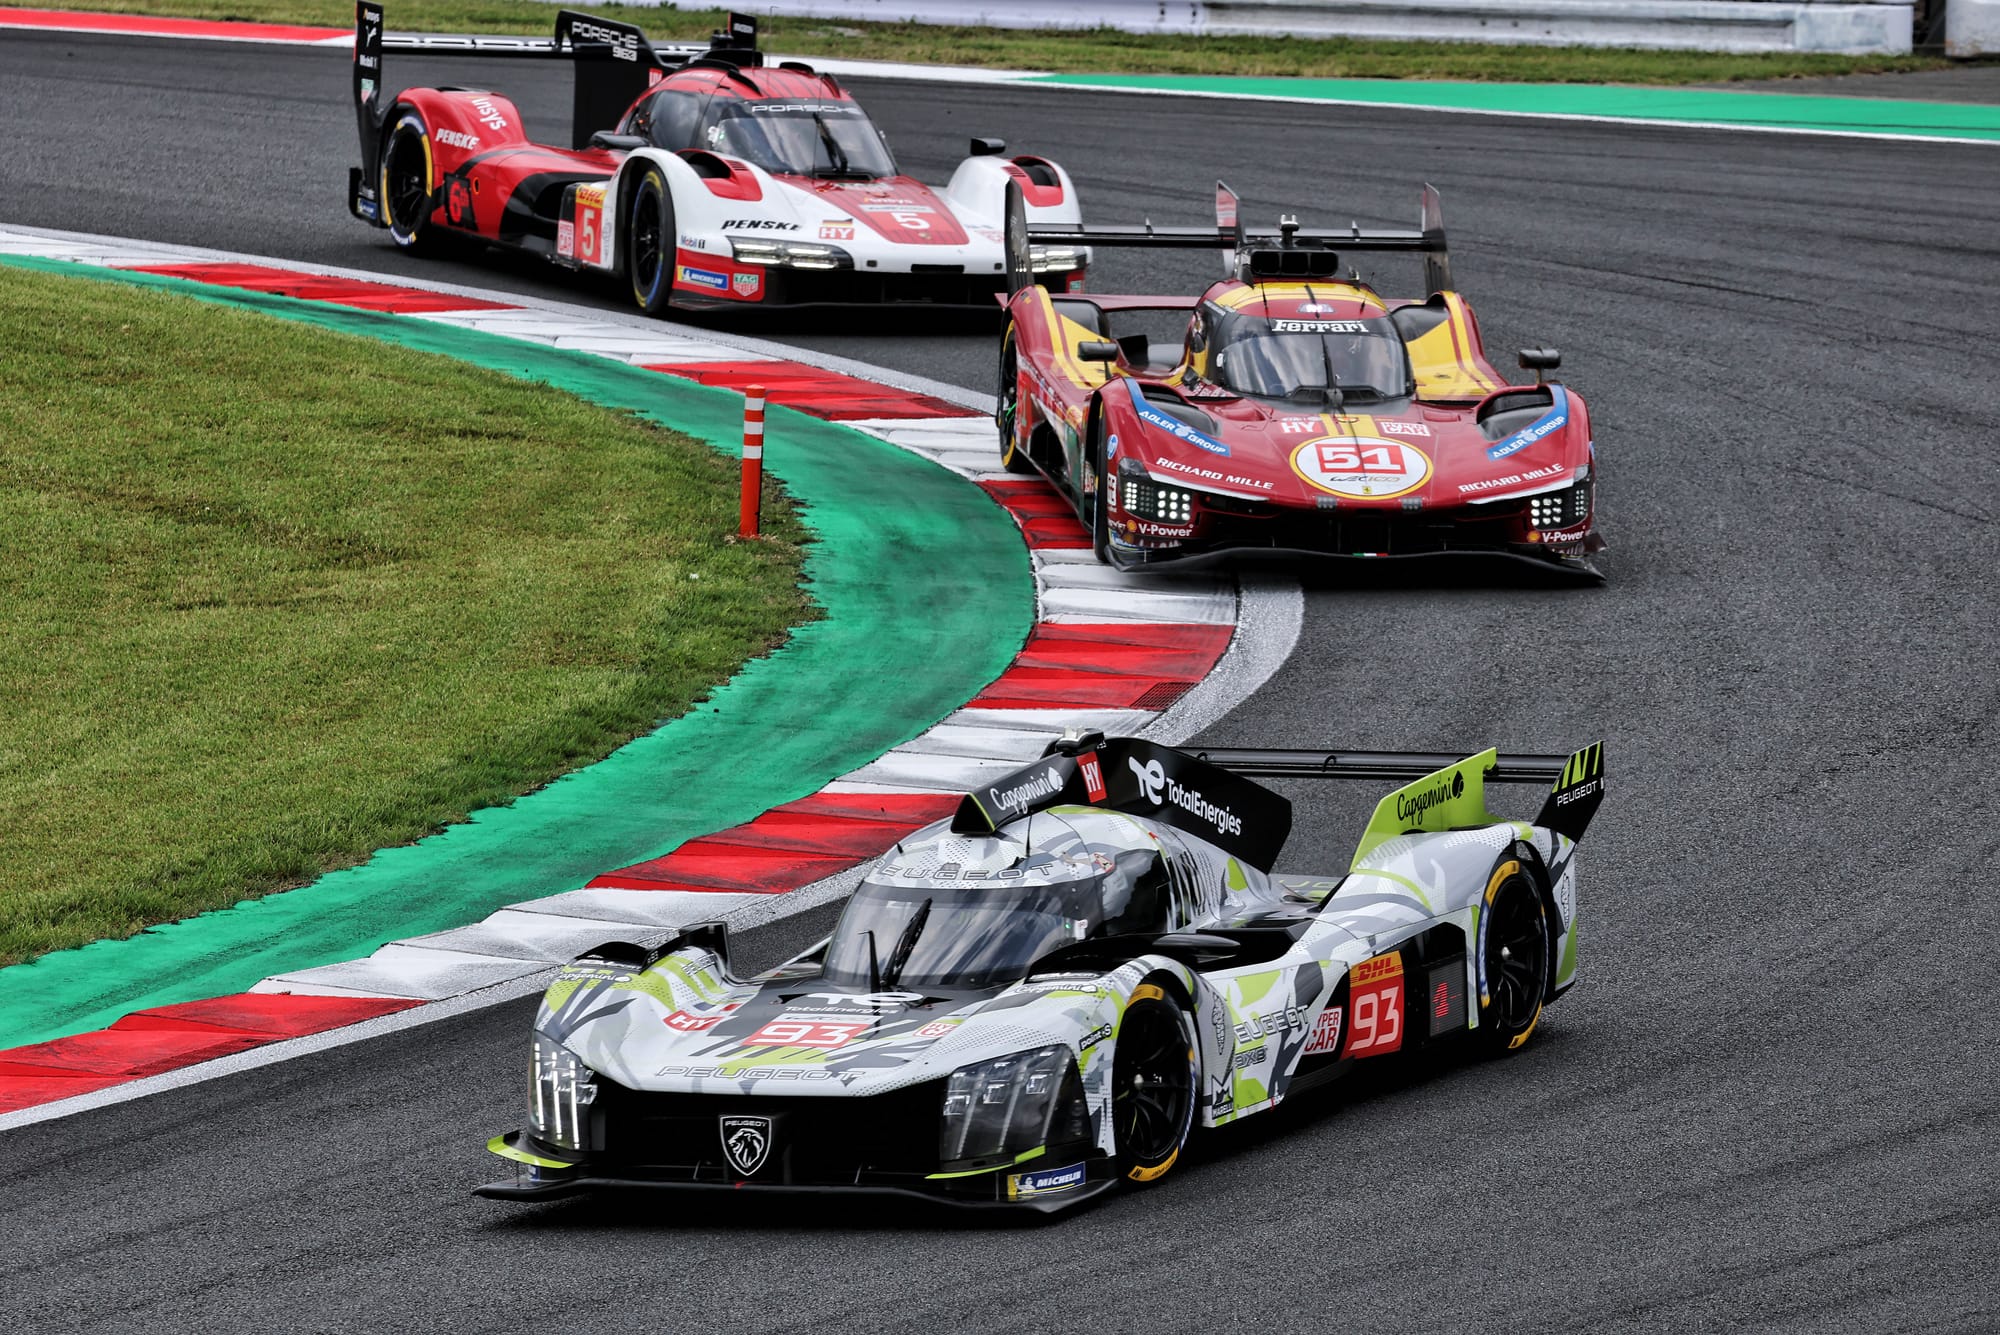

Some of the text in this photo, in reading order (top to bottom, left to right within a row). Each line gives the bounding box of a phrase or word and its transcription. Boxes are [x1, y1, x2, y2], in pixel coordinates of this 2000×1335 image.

[572, 21, 639, 49] PORSCHE
[612, 46, 637, 62] 963
[752, 105, 863, 115] PORSCHE
[435, 128, 480, 150] PENSKE
[721, 220, 801, 231] PENSKE
[891, 212, 930, 230] 5
[582, 208, 595, 256] 5
[820, 228, 850, 239] HY
[691, 272, 724, 285] MICHELIN
[735, 276, 757, 284] TAG
[1272, 319, 1369, 333] Ferrari
[1139, 410, 1226, 454] ADLER GROUP
[1282, 421, 1315, 433] HY
[1492, 416, 1566, 458] ADLER GROUP
[1320, 447, 1402, 471] 51
[1156, 457, 1274, 490] RICHARD MILLE
[1458, 463, 1564, 493] RICHARD MILLE
[1138, 523, 1192, 537] V-Power
[1542, 530, 1584, 543] V-Power
[1082, 761, 1101, 793] HY
[990, 772, 1050, 815] Capgemini
[1397, 777, 1452, 826] Capgemini
[1557, 780, 1598, 807] PEUGEOT
[1166, 777, 1242, 836] TotalEnergies
[873, 858, 1053, 881] PEUGEOT
[1359, 957, 1395, 982] DHL
[785, 1006, 899, 1014] TotalEnergies
[1316, 1012, 1339, 1028] YPER
[1350, 986, 1400, 1051] 93
[670, 1015, 712, 1030] HY
[759, 1024, 850, 1045] 93
[655, 1065, 866, 1081] PEUGEOT
[1036, 1170, 1082, 1188] MICHELIN
